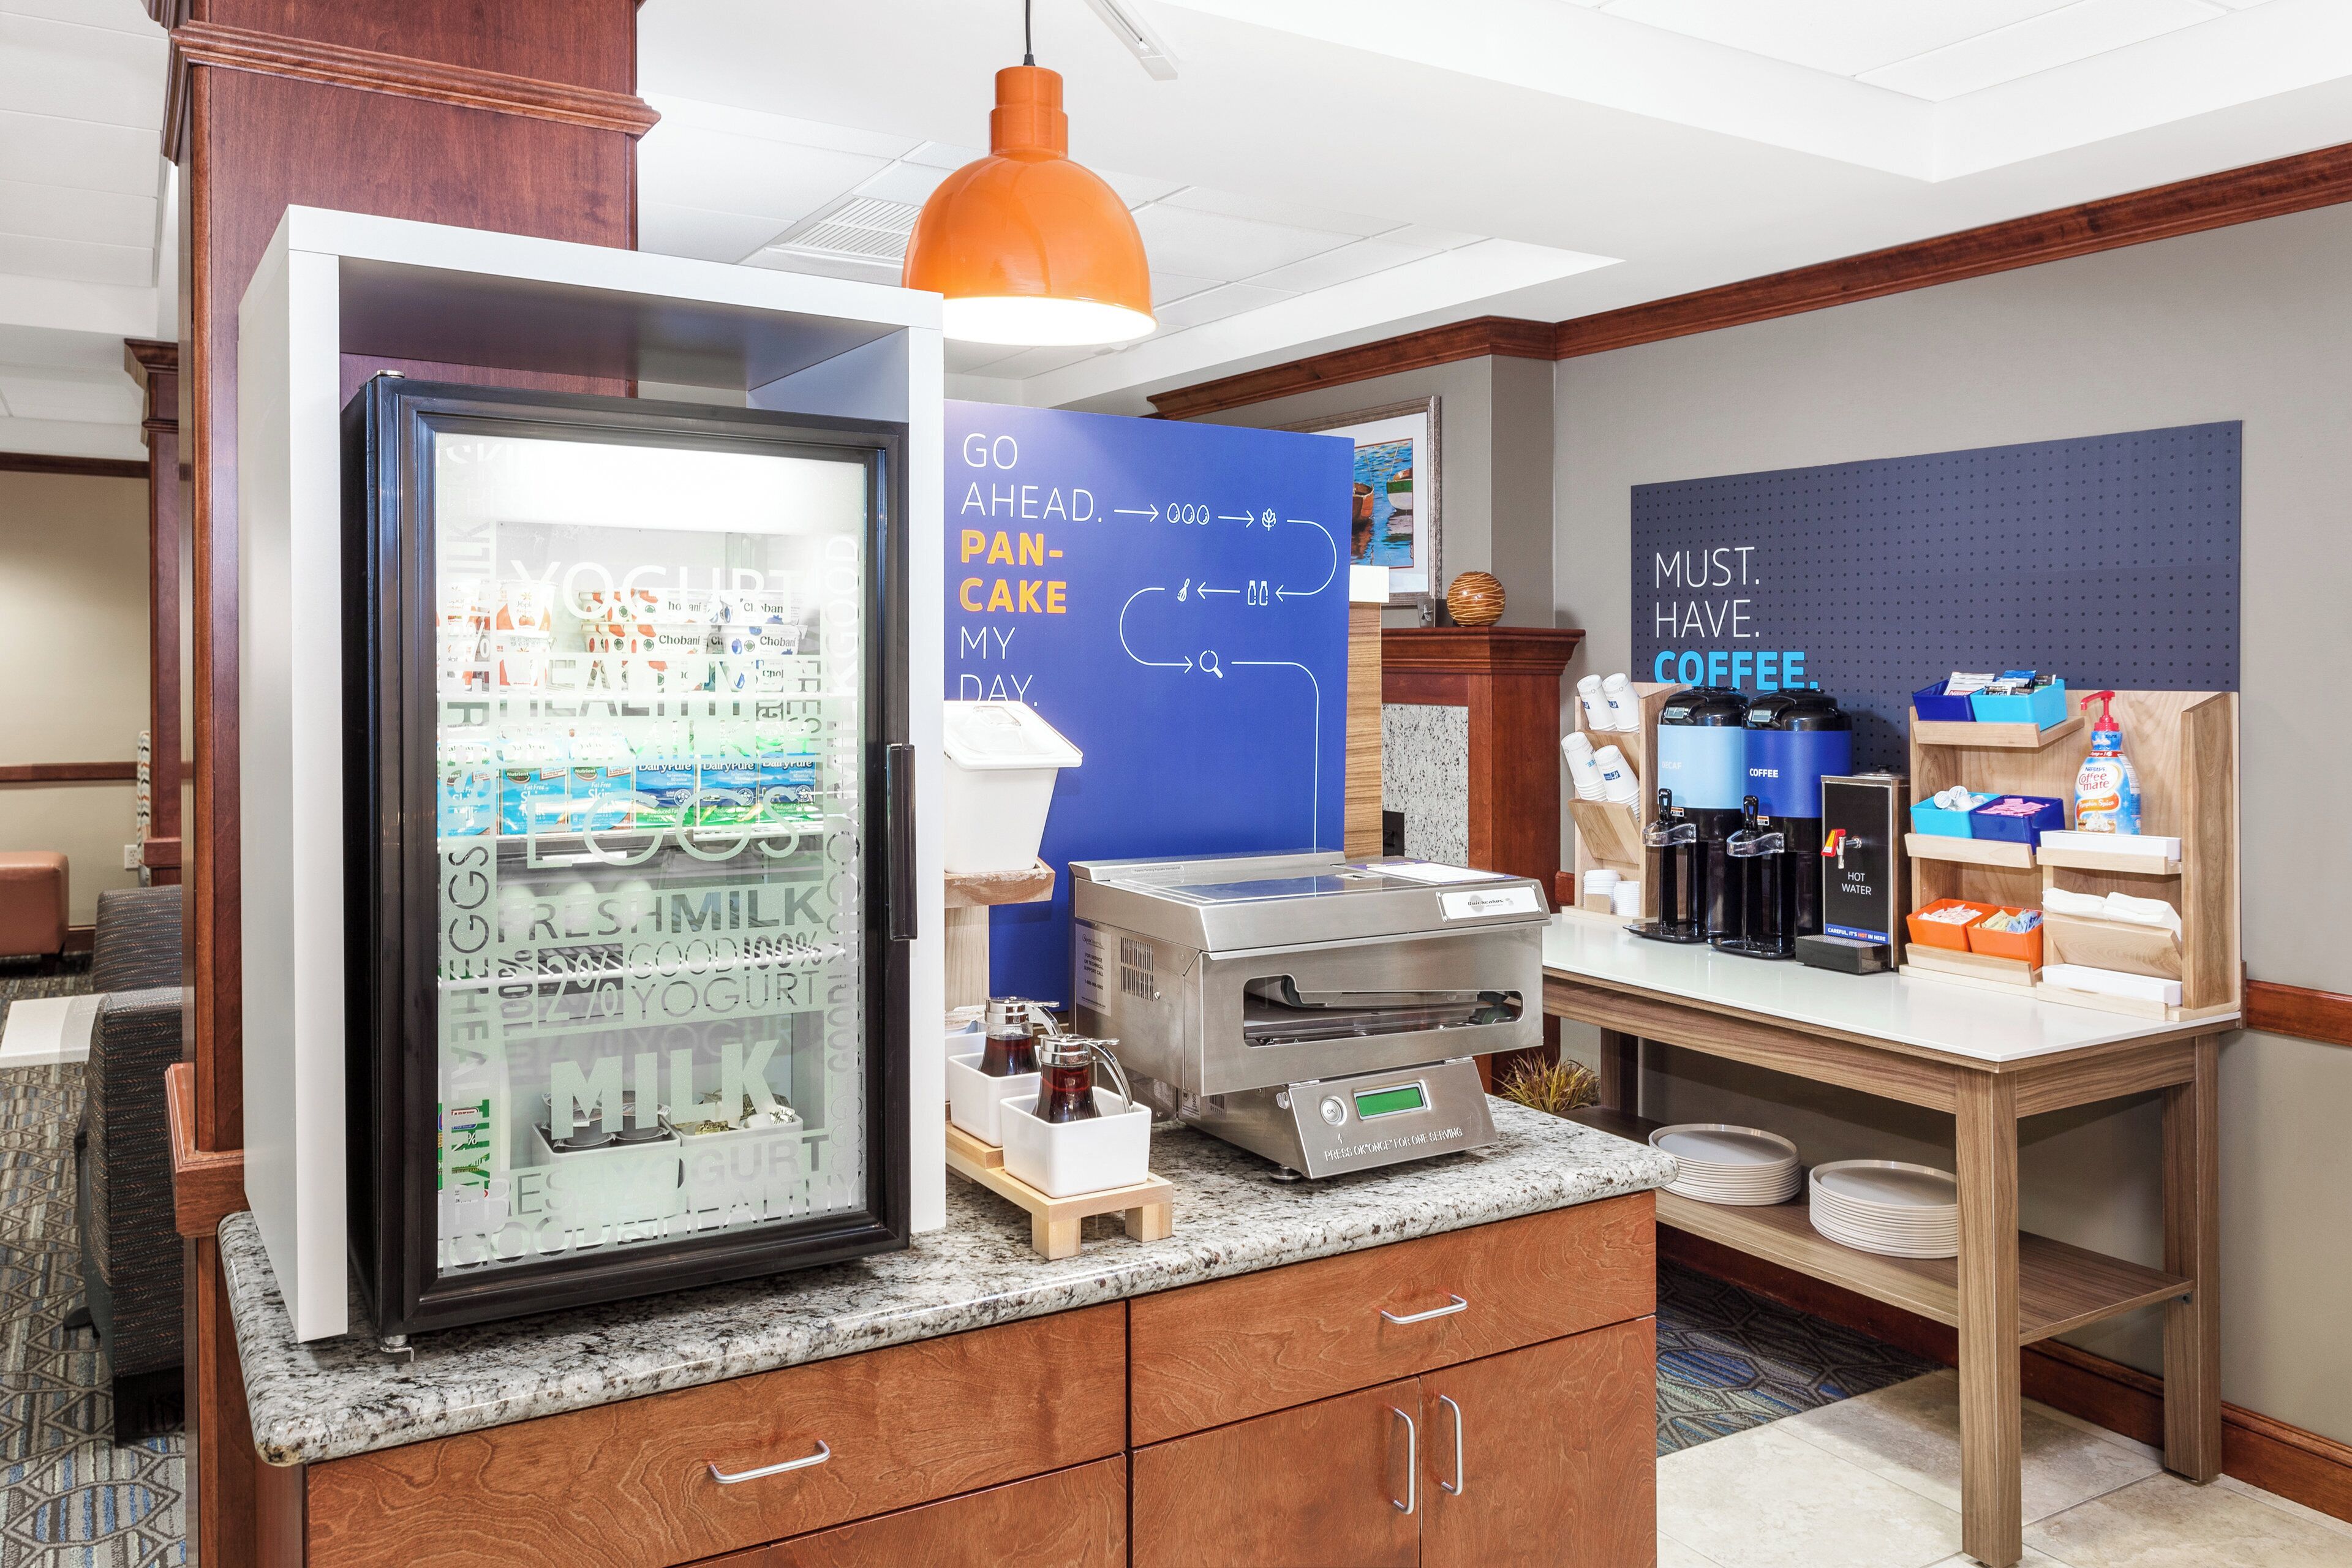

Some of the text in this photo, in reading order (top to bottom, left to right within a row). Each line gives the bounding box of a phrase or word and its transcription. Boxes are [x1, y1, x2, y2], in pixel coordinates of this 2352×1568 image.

[963, 433, 1019, 470] GO
[961, 481, 1102, 523] AHEAD.
[960, 529, 1063, 567] PAN-
[1656, 546, 1760, 589] MUST.
[510, 558, 804, 624] YOGURT
[824, 535, 859, 658] GOOD
[959, 578, 1067, 614] CAKE
[1656, 599, 1760, 638] HAVE.
[659, 635, 701, 646] Chobani
[760, 635, 796, 647] Chobani
[960, 626, 1016, 660] MY
[499, 659, 755, 717] HEALTHY
[959, 674, 1038, 706] DAY.
[1654, 650, 1819, 690] COFFEE.
[1662, 761, 1682, 770] DECAF
[1749, 767, 1779, 778] COFFEE
[2083, 780, 2109, 791] mate
[527, 788, 800, 869] EGGS
[1841, 883, 1872, 895] WATER
[1848, 872, 1866, 883] HOT
[448, 846, 490, 980] EGGS
[671, 886, 824, 933] MILK
[628, 930, 823, 979] GOOD 100%
[497, 949, 533, 1037] 100%
[546, 951, 619, 1022] 2%
[630, 970, 820, 1020] YOGURT
[551, 1040, 781, 1140] MILK
[1324, 1147, 1353, 1161] PRESS
[1394, 1137, 1411, 1149] FOR
[1411, 1133, 1428, 1145] ONE
[1429, 1127, 1463, 1142] SERVING
[448, 1212, 614, 1272] GOOD
